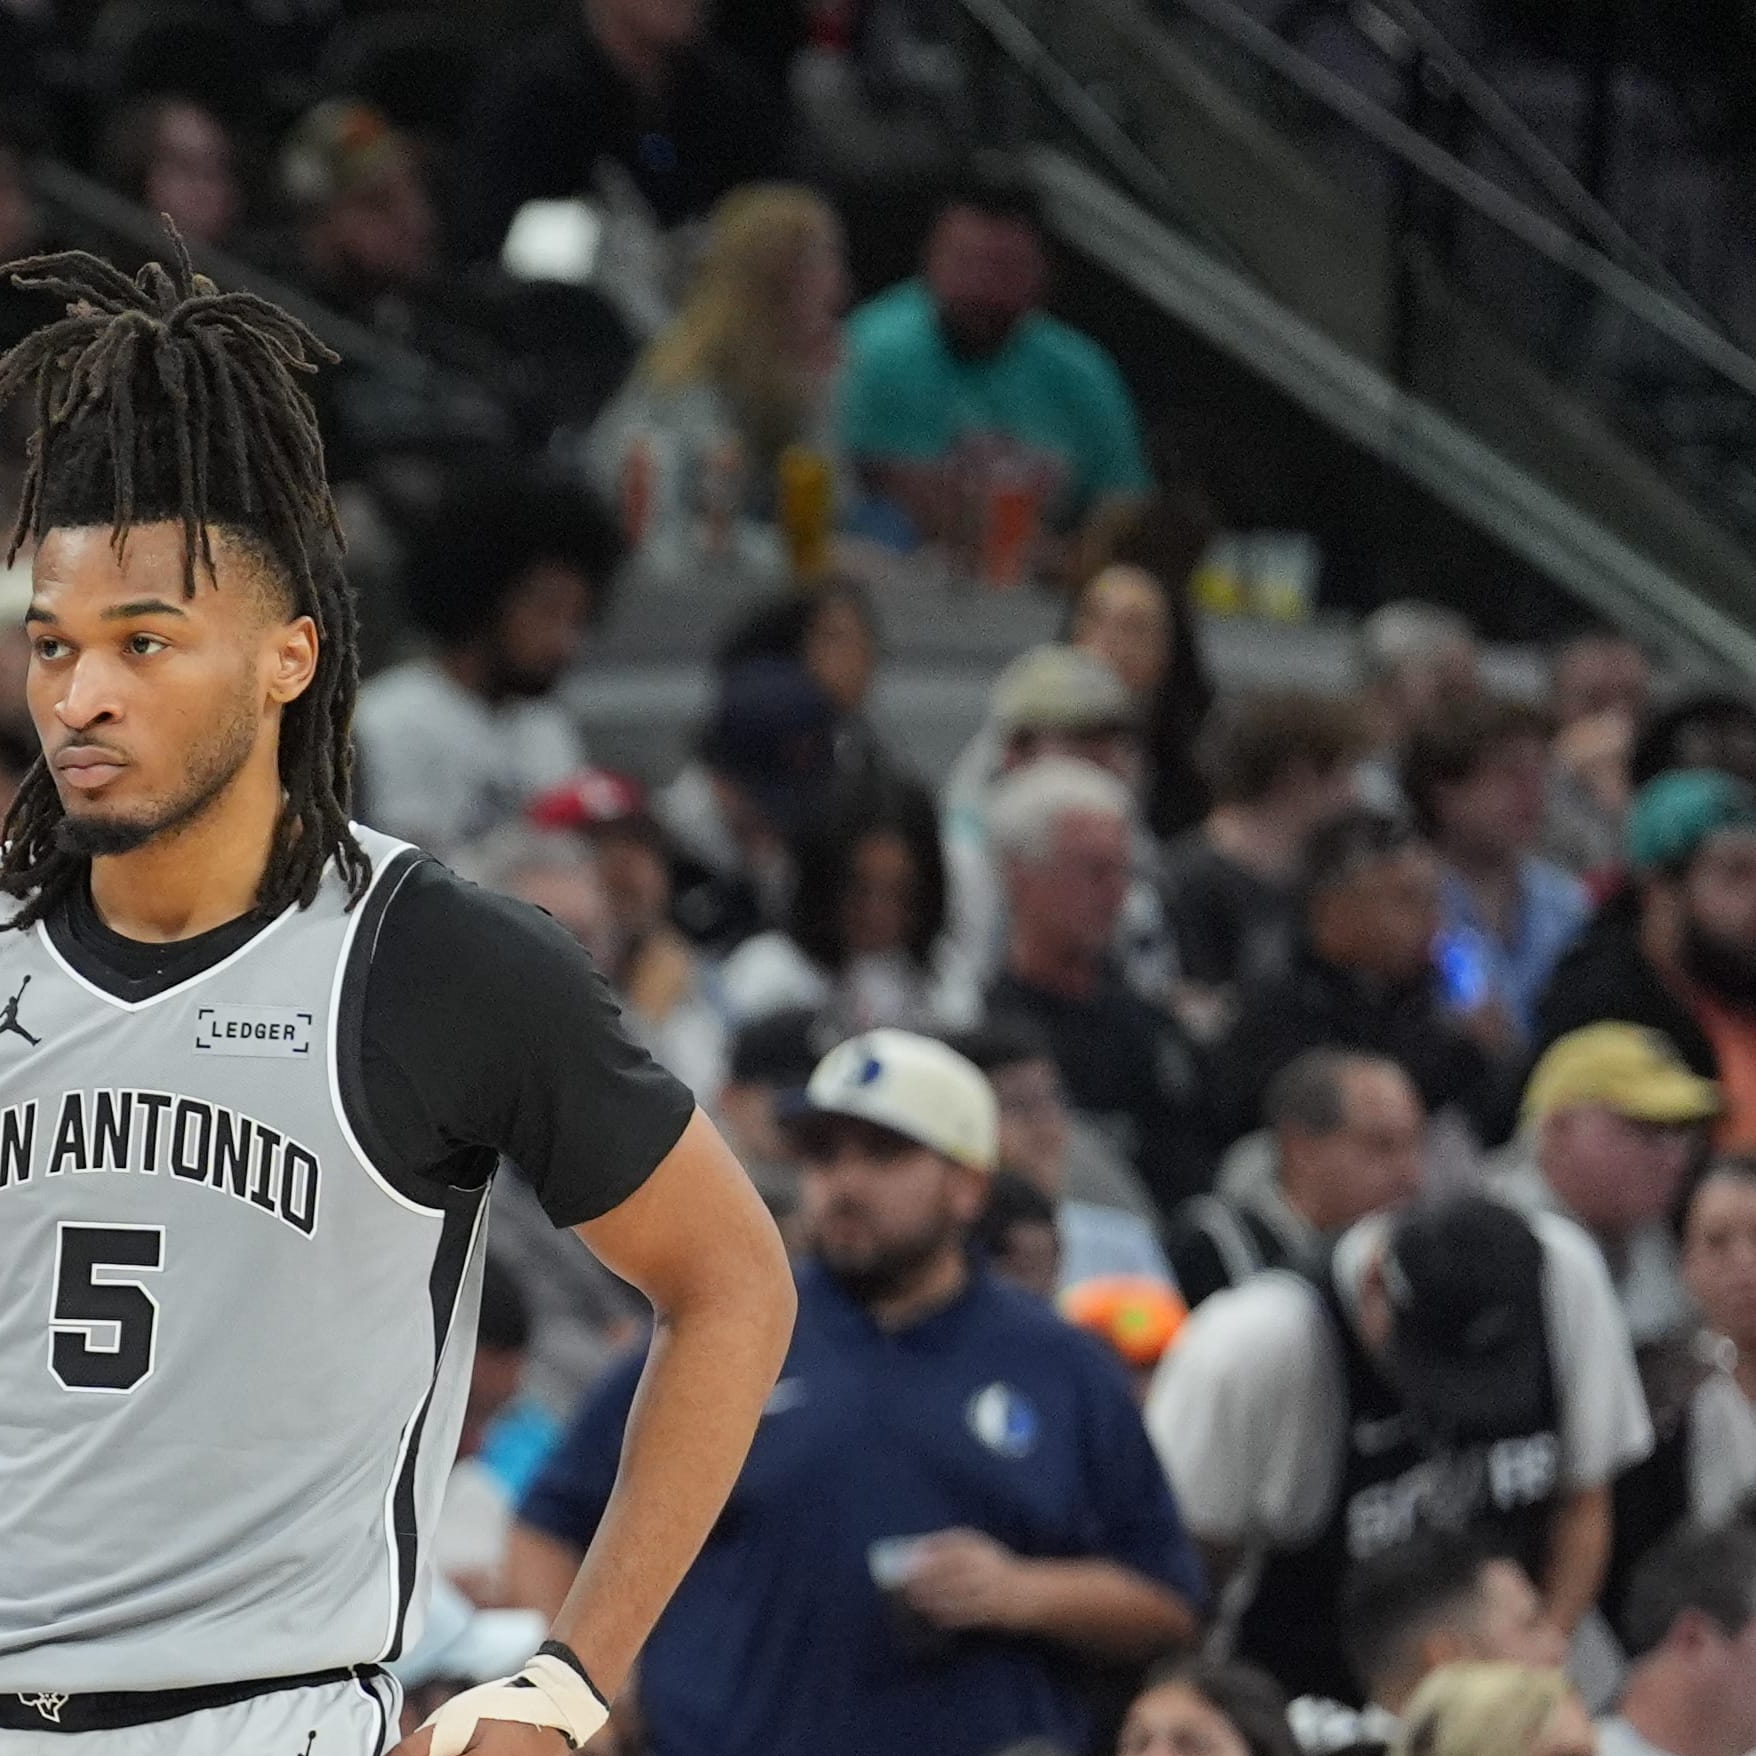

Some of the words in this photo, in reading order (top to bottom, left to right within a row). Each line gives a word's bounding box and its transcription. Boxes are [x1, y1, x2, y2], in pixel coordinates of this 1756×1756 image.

[211, 1020, 296, 1041] LEDGER
[45, 1087, 322, 1241] ANTONIO
[47, 1221, 166, 1395] 5
